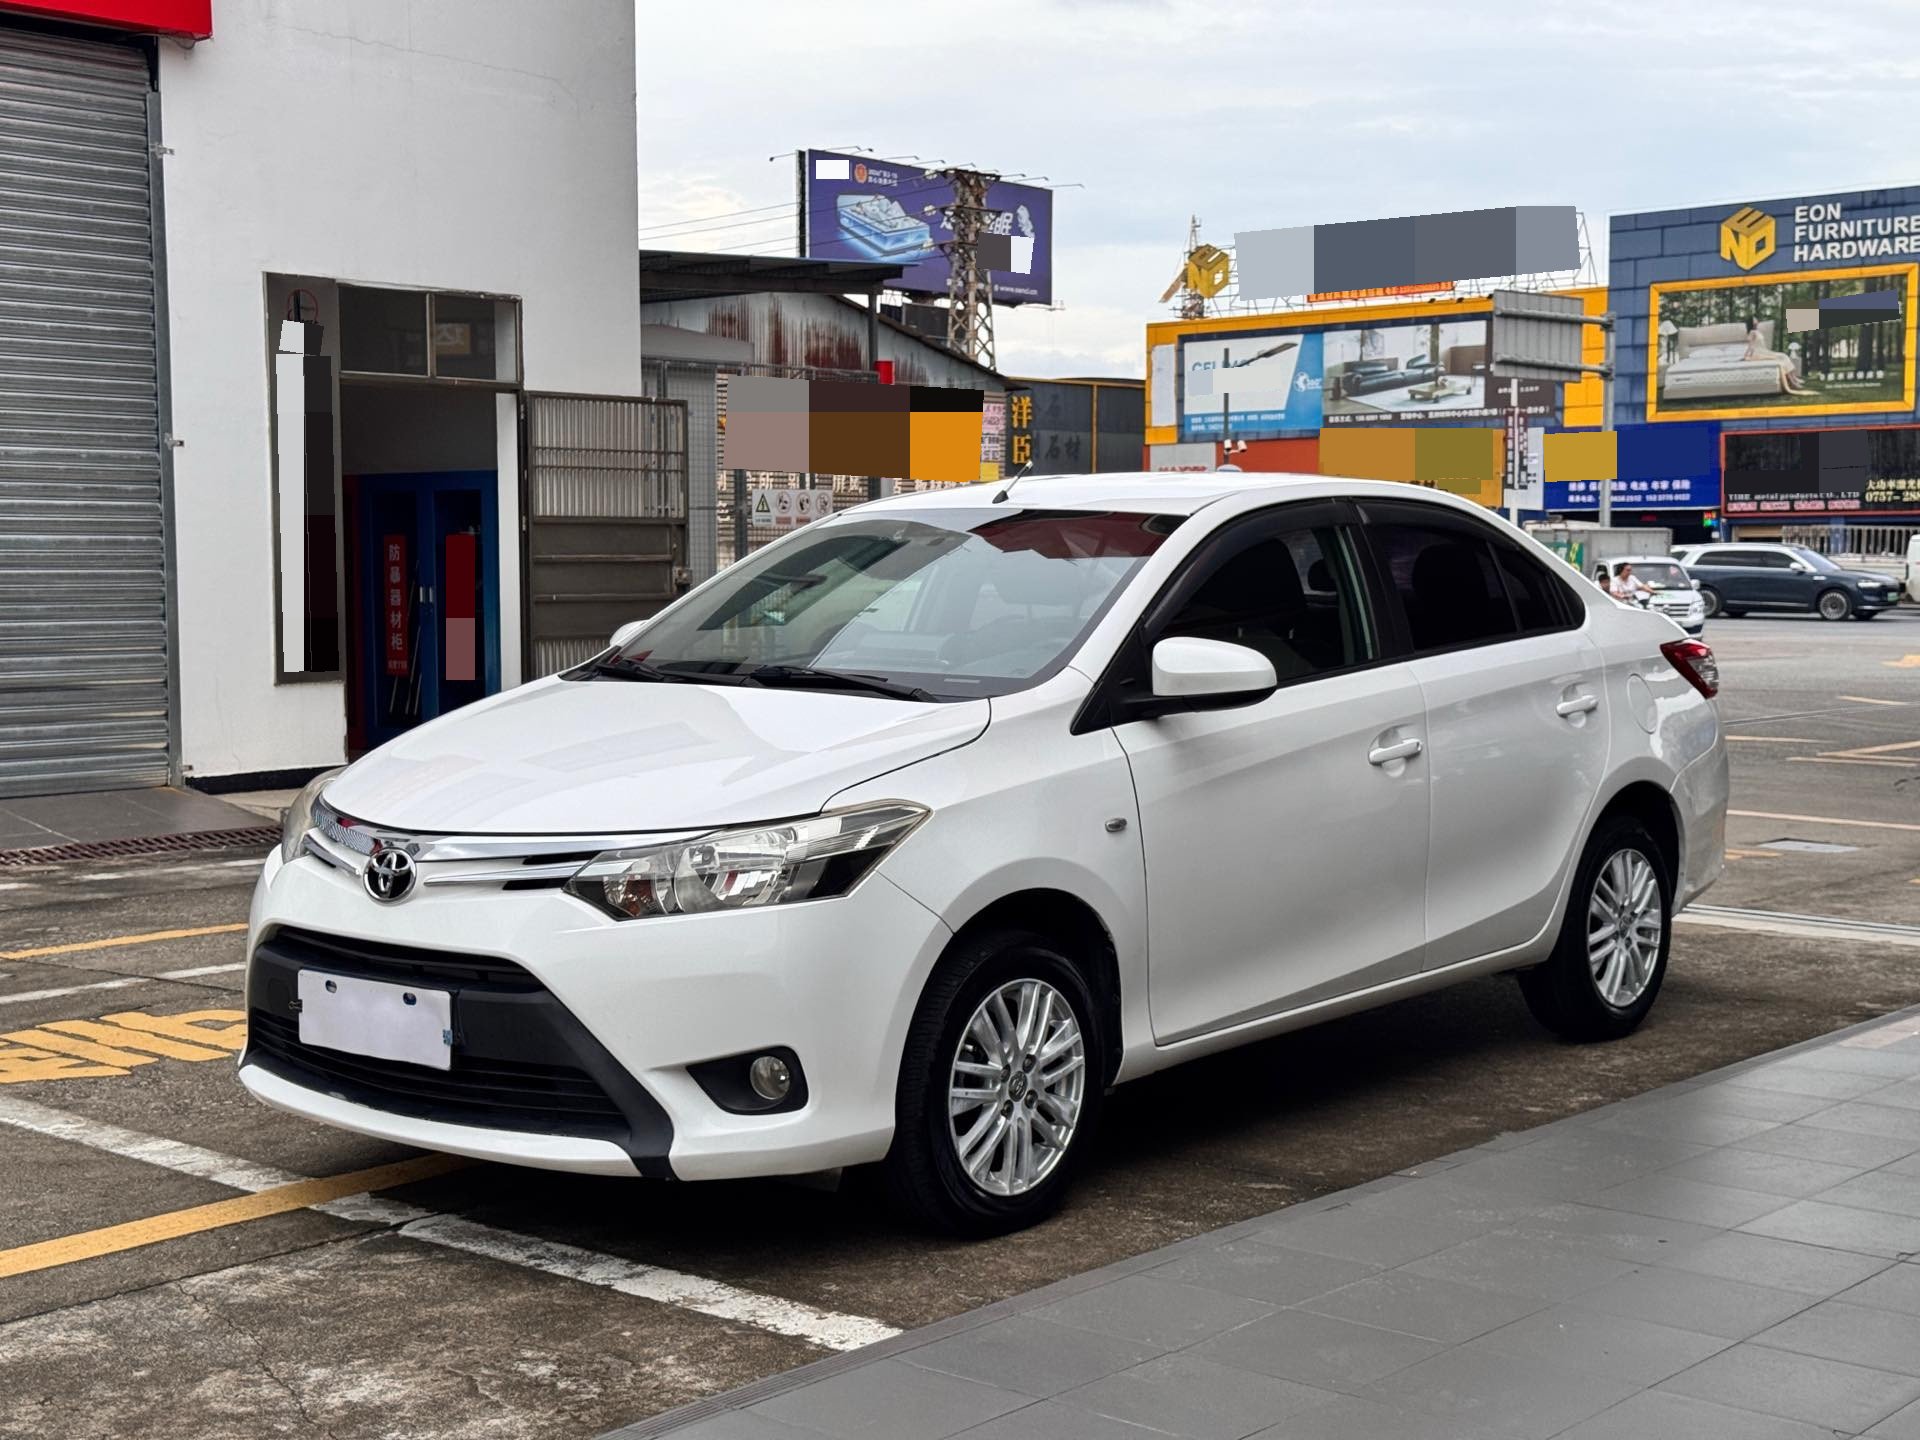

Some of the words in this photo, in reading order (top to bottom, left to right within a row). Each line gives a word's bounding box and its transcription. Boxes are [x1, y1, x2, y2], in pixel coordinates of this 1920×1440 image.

[1795, 203, 1841, 223] EON
[1794, 216, 1920, 243] FURNITURE
[1793, 236, 1920, 263] HARDWARE
